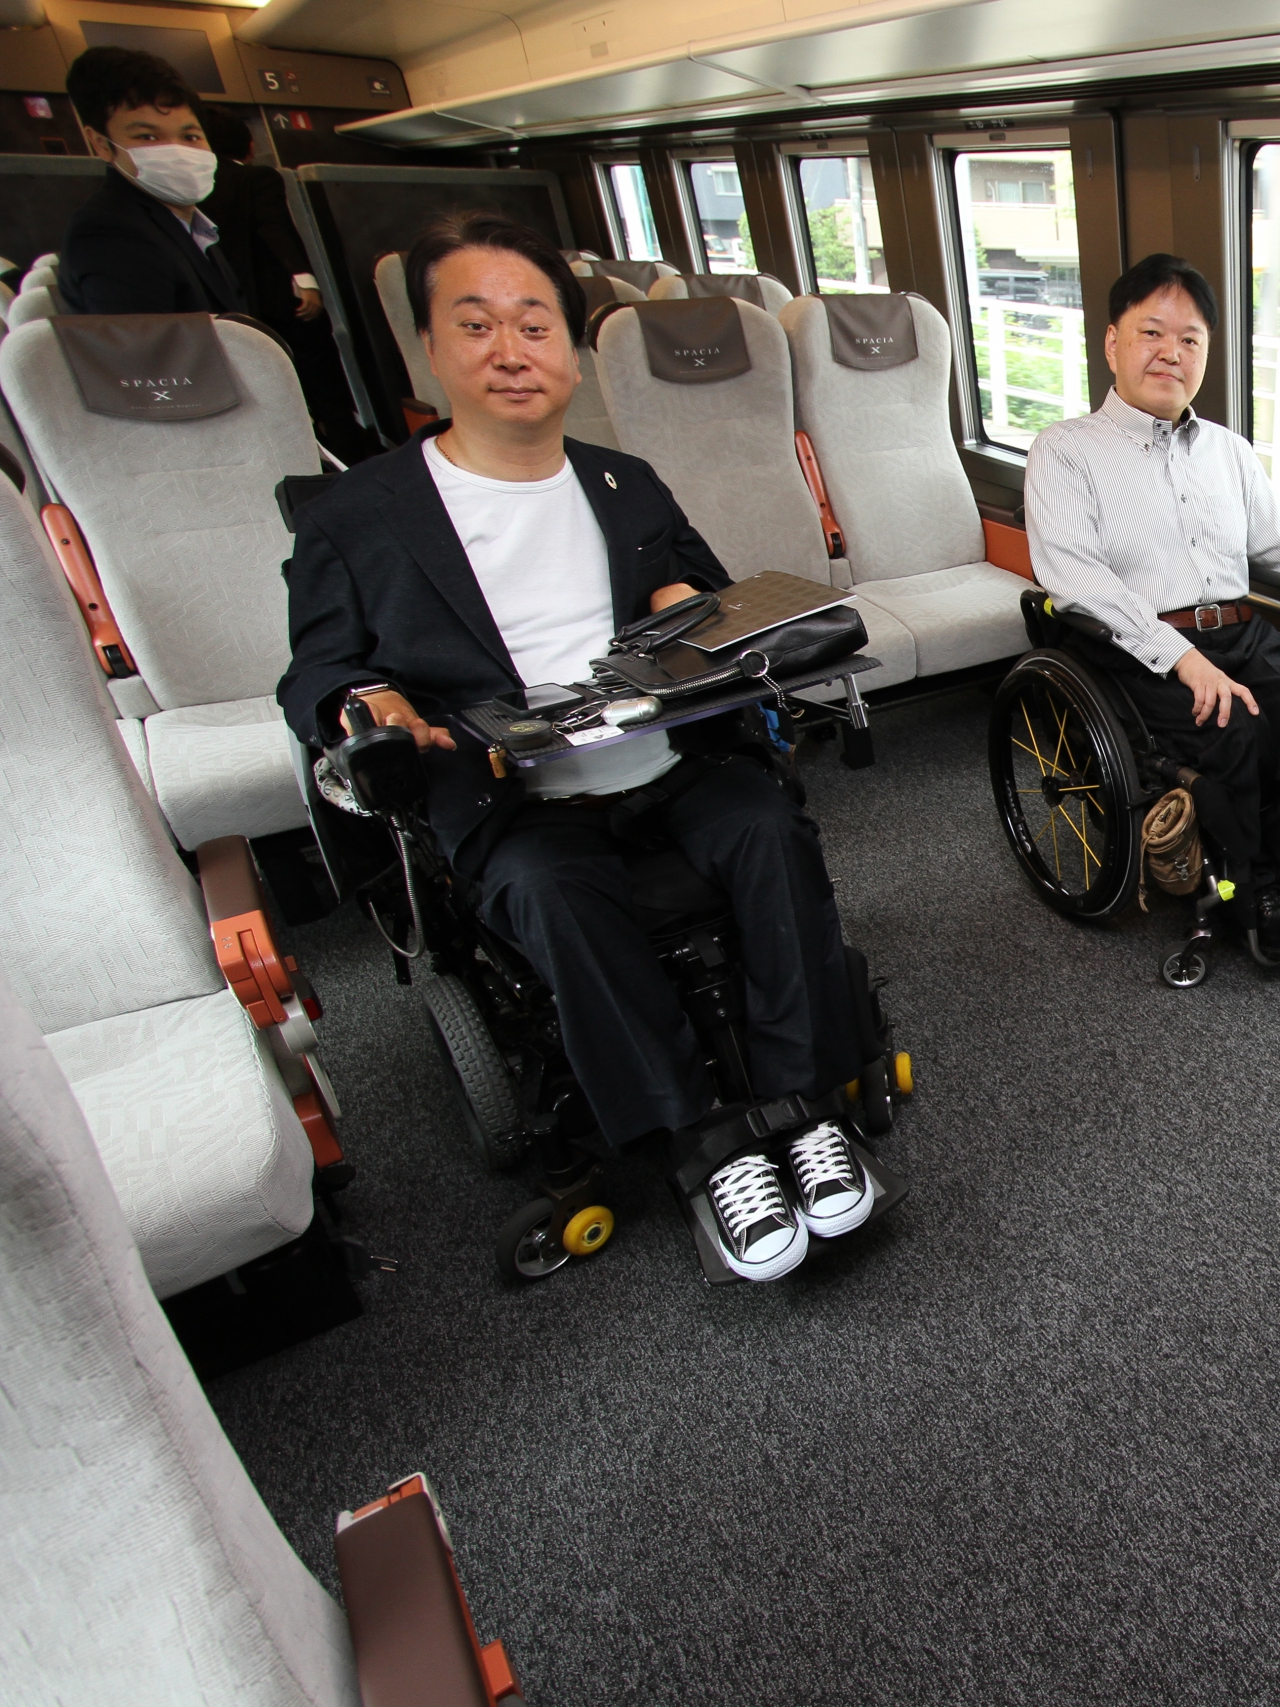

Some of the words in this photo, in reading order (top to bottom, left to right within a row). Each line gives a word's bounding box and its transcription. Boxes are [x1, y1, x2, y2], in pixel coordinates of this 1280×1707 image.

[264, 71, 280, 90] 5
[855, 337, 894, 345] SPACIA
[674, 347, 721, 356] SPACIA
[870, 346, 882, 355] X
[694, 358, 707, 367] X
[120, 377, 193, 388] SPACIA
[151, 390, 173, 402] X
